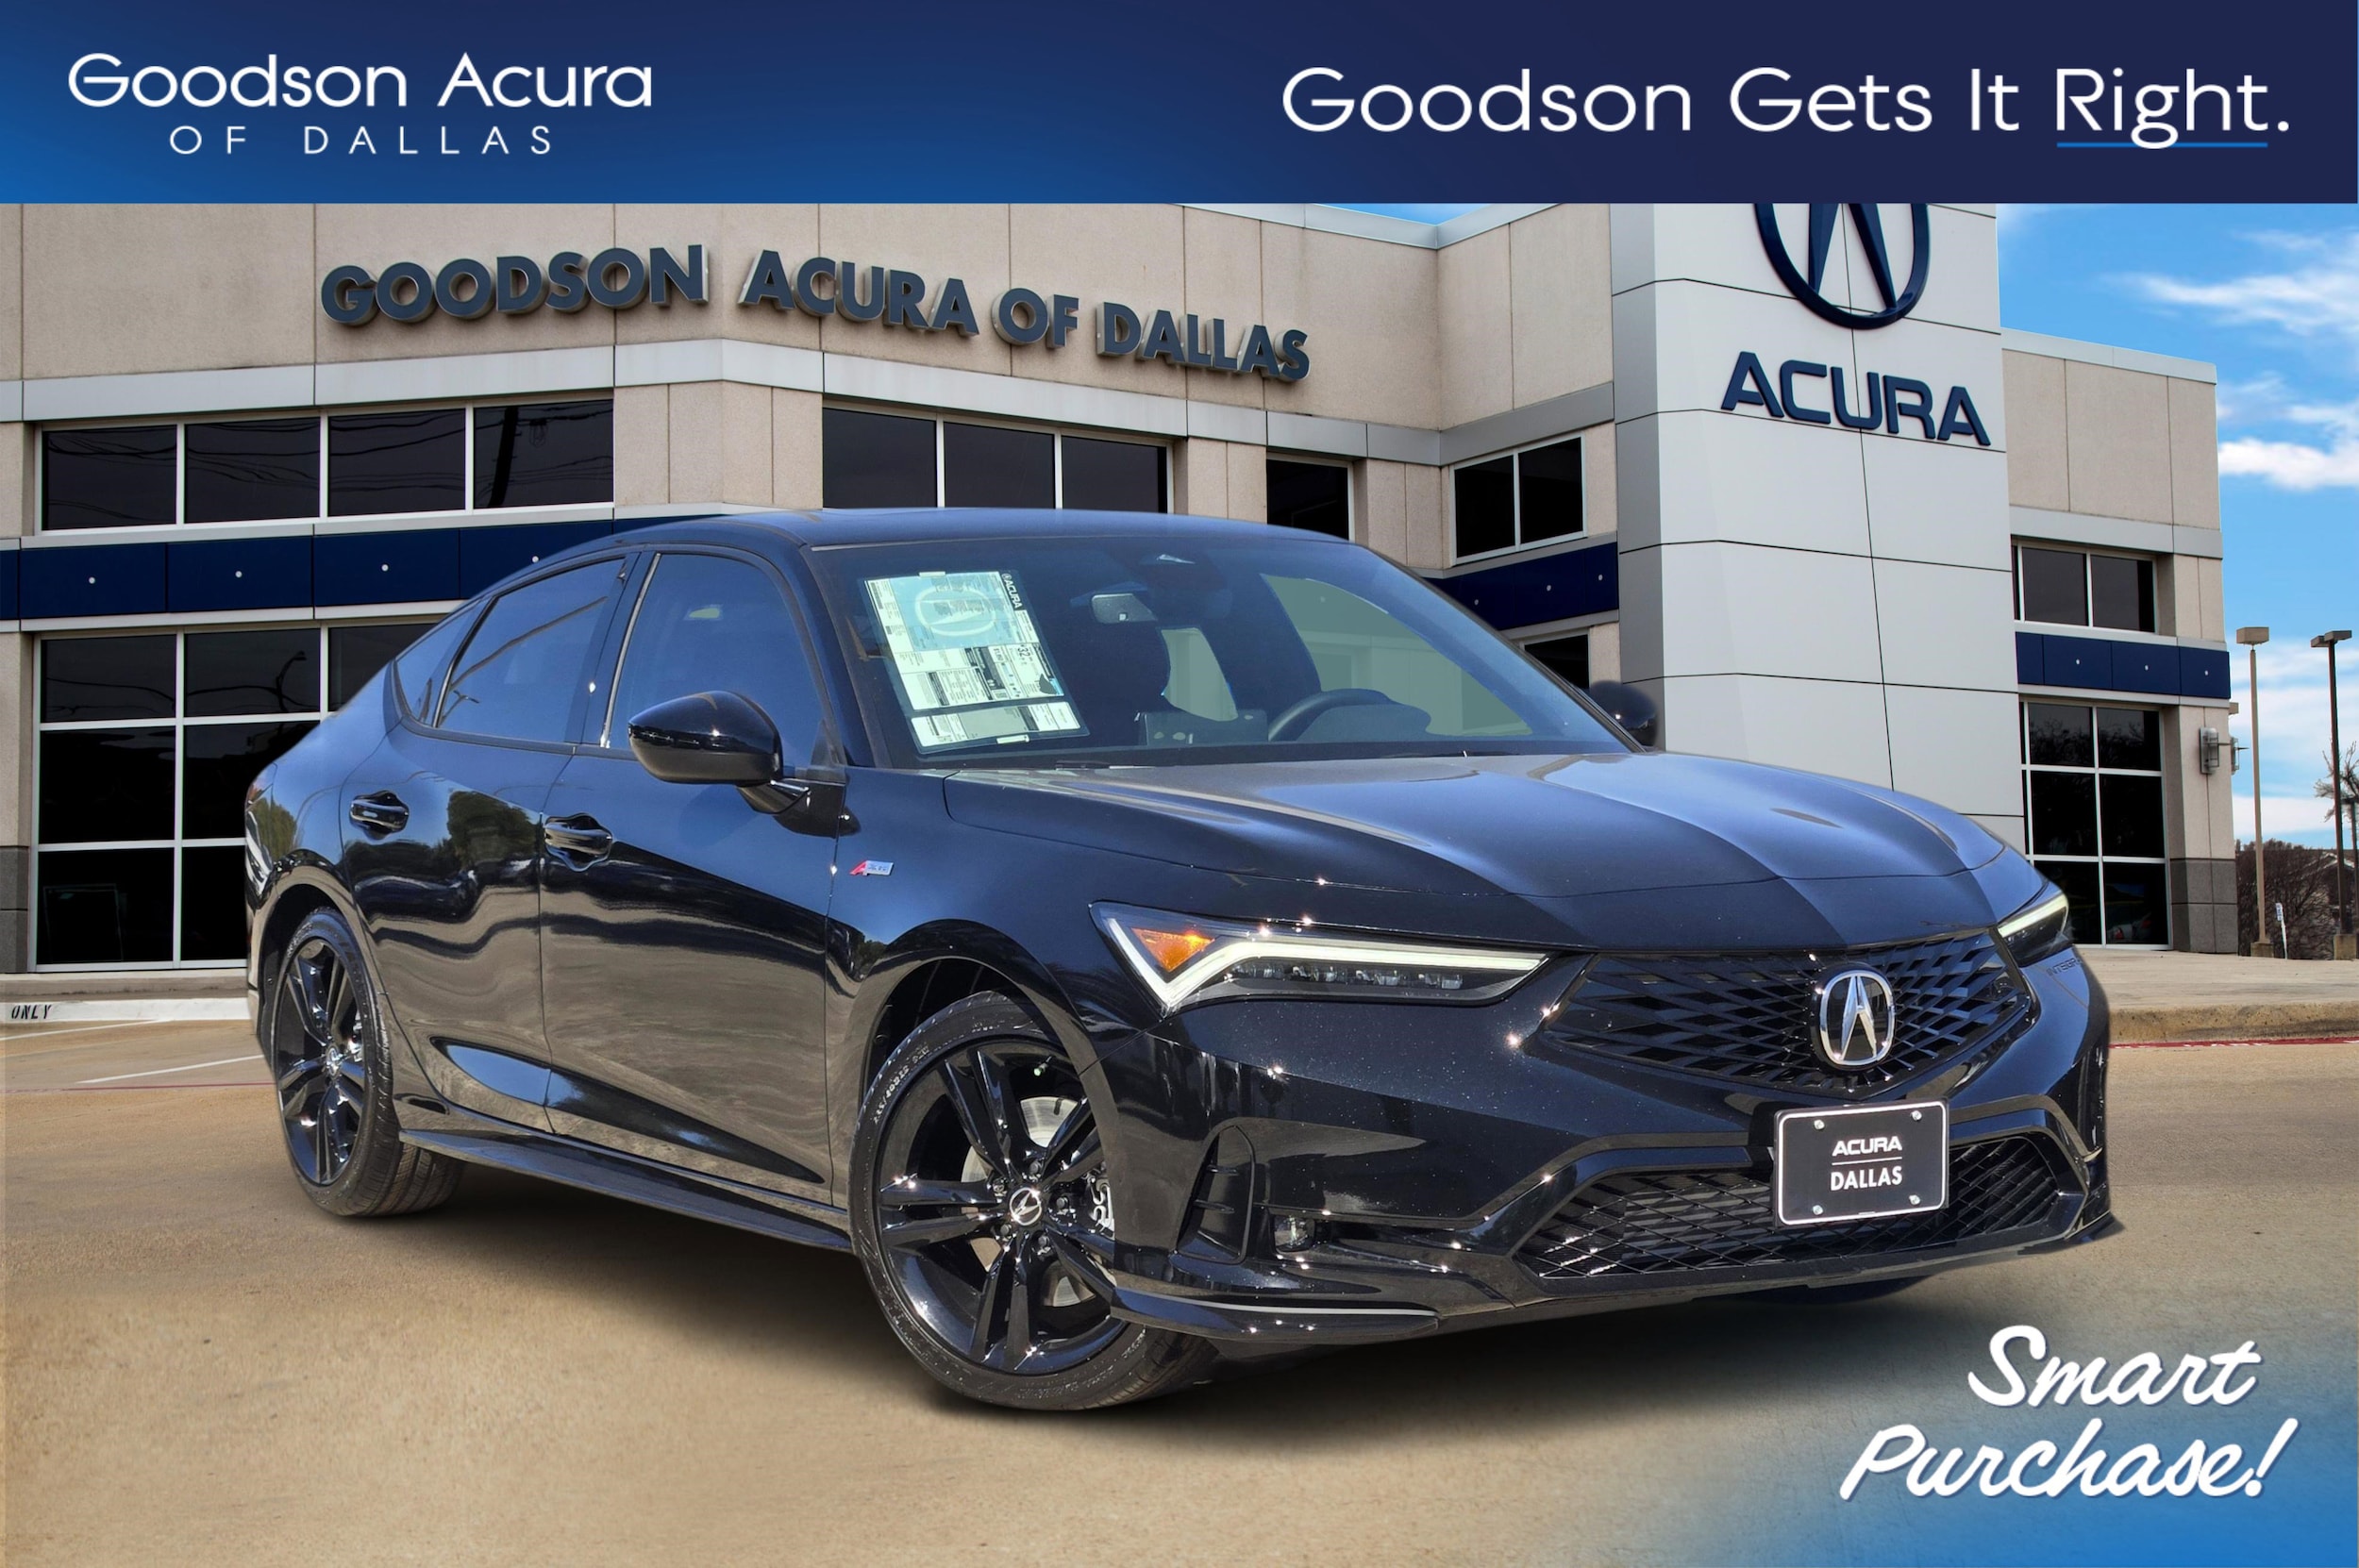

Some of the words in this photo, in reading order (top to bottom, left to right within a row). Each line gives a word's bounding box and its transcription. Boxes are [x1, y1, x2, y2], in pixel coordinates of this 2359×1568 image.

[321, 243, 709, 327] GOODSON
[739, 249, 979, 336] ACURA
[992, 287, 1079, 349] OF
[1096, 301, 1310, 383] DALLAS
[1720, 350, 1991, 447] ACURA
[1004, 579, 1023, 609] ACURA
[11, 1004, 53, 1021] ONLY
[1832, 1135, 1903, 1158] ACURA
[1831, 1165, 1903, 1192] DALLAS
